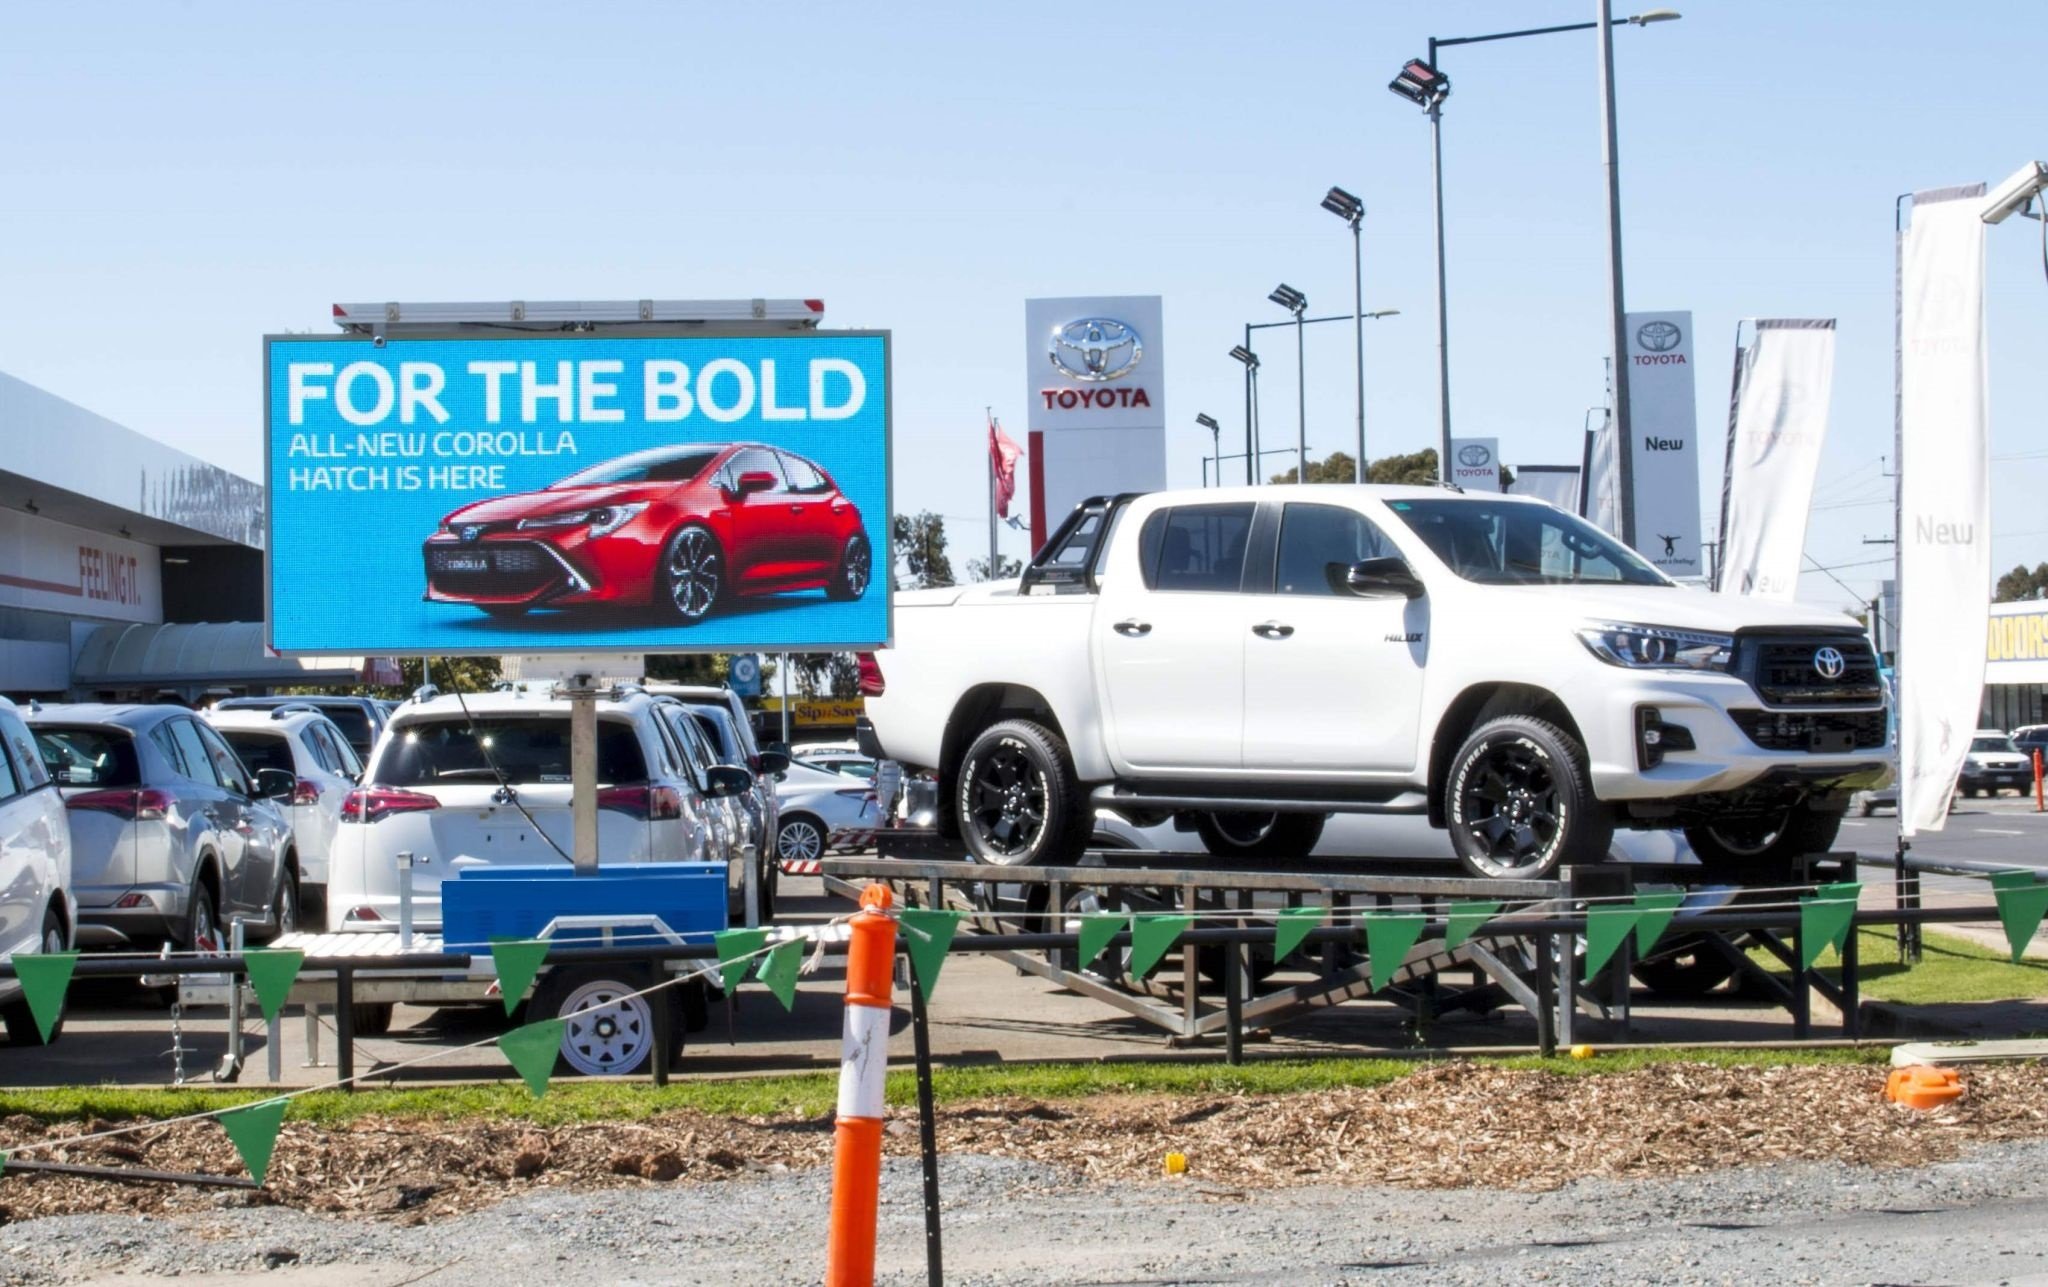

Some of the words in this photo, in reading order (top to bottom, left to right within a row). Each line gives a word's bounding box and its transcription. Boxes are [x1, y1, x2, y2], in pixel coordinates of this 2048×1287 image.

[1634, 354, 1687, 365] TOYOTA
[289, 361, 450, 425] FOR
[467, 359, 625, 423] THE
[644, 357, 866, 422] BOLD
[1041, 388, 1151, 410] TOYOTA
[288, 433, 426, 457] ALL-NEW
[432, 430, 578, 456] COROLLA
[1645, 437, 1684, 451] New
[289, 466, 389, 491] HATCH
[396, 465, 422, 490] IS
[429, 464, 506, 490] HERE
[1456, 468, 1493, 477] TOYOTA
[1915, 514, 1974, 545] New
[79, 546, 126, 605] FEELING
[1384, 632, 1423, 642] HILUX
[798, 706, 822, 721] Sip
[1453, 741, 1489, 825] GRANDTREK
